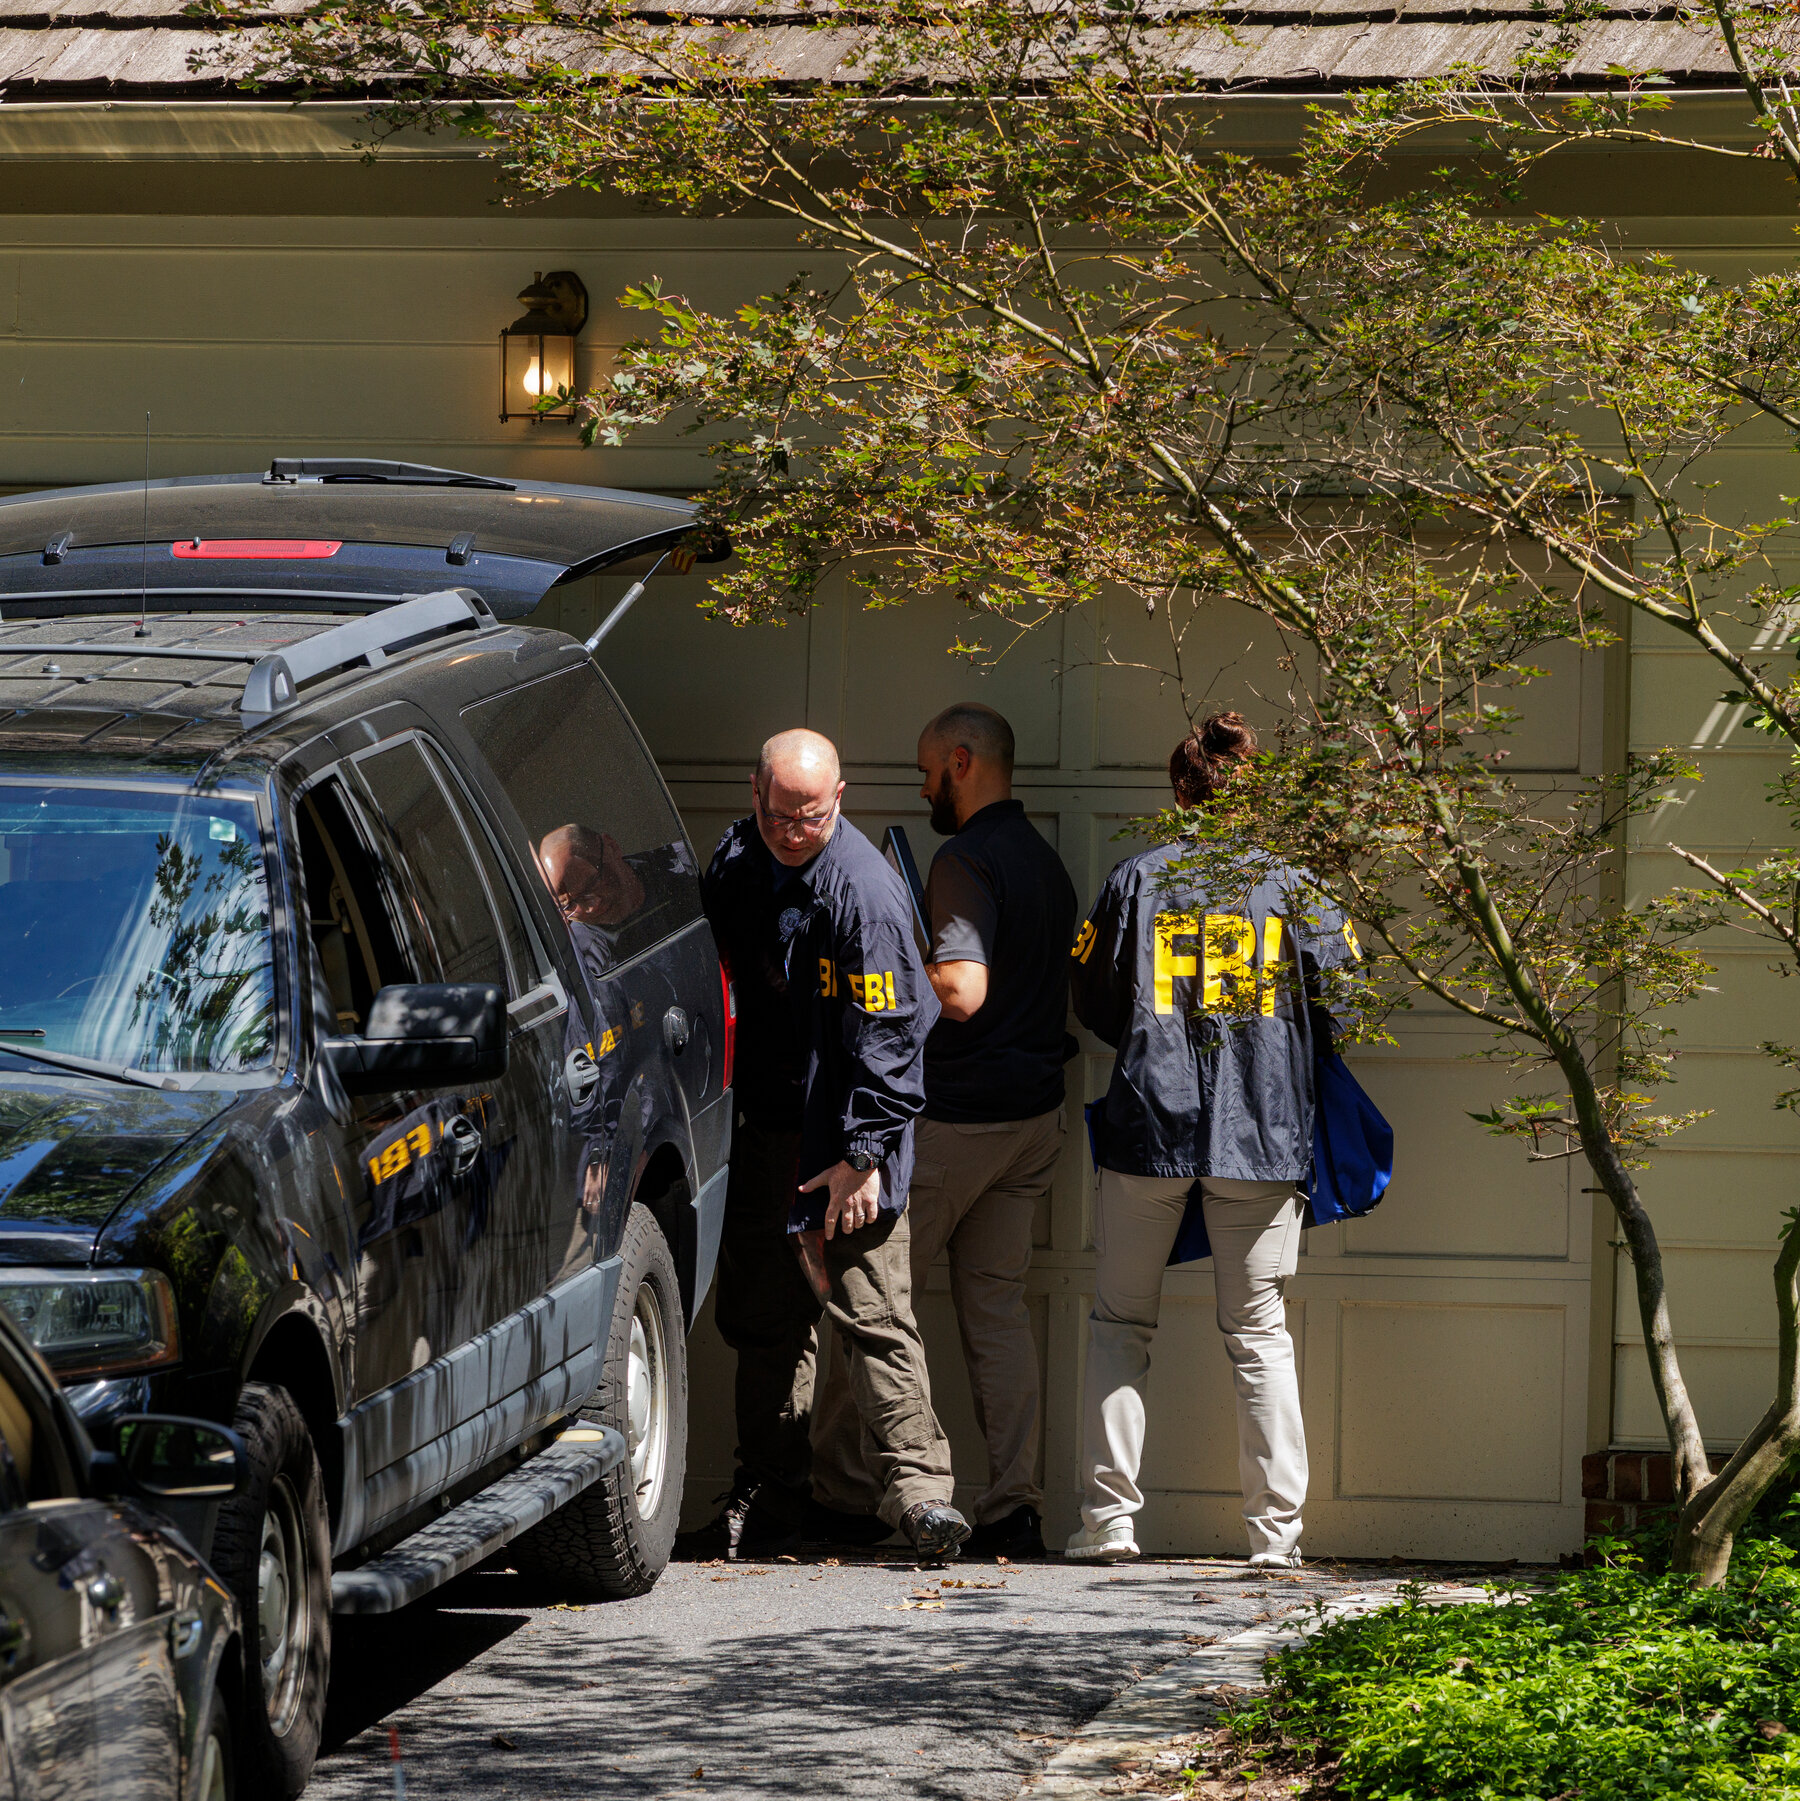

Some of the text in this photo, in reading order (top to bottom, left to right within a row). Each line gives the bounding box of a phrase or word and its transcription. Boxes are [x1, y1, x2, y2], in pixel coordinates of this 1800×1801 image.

[1070, 919, 1098, 965] BI
[818, 957, 838, 998] BI
[1154, 912, 1283, 1018] FBI
[847, 971, 897, 1012] FBI
